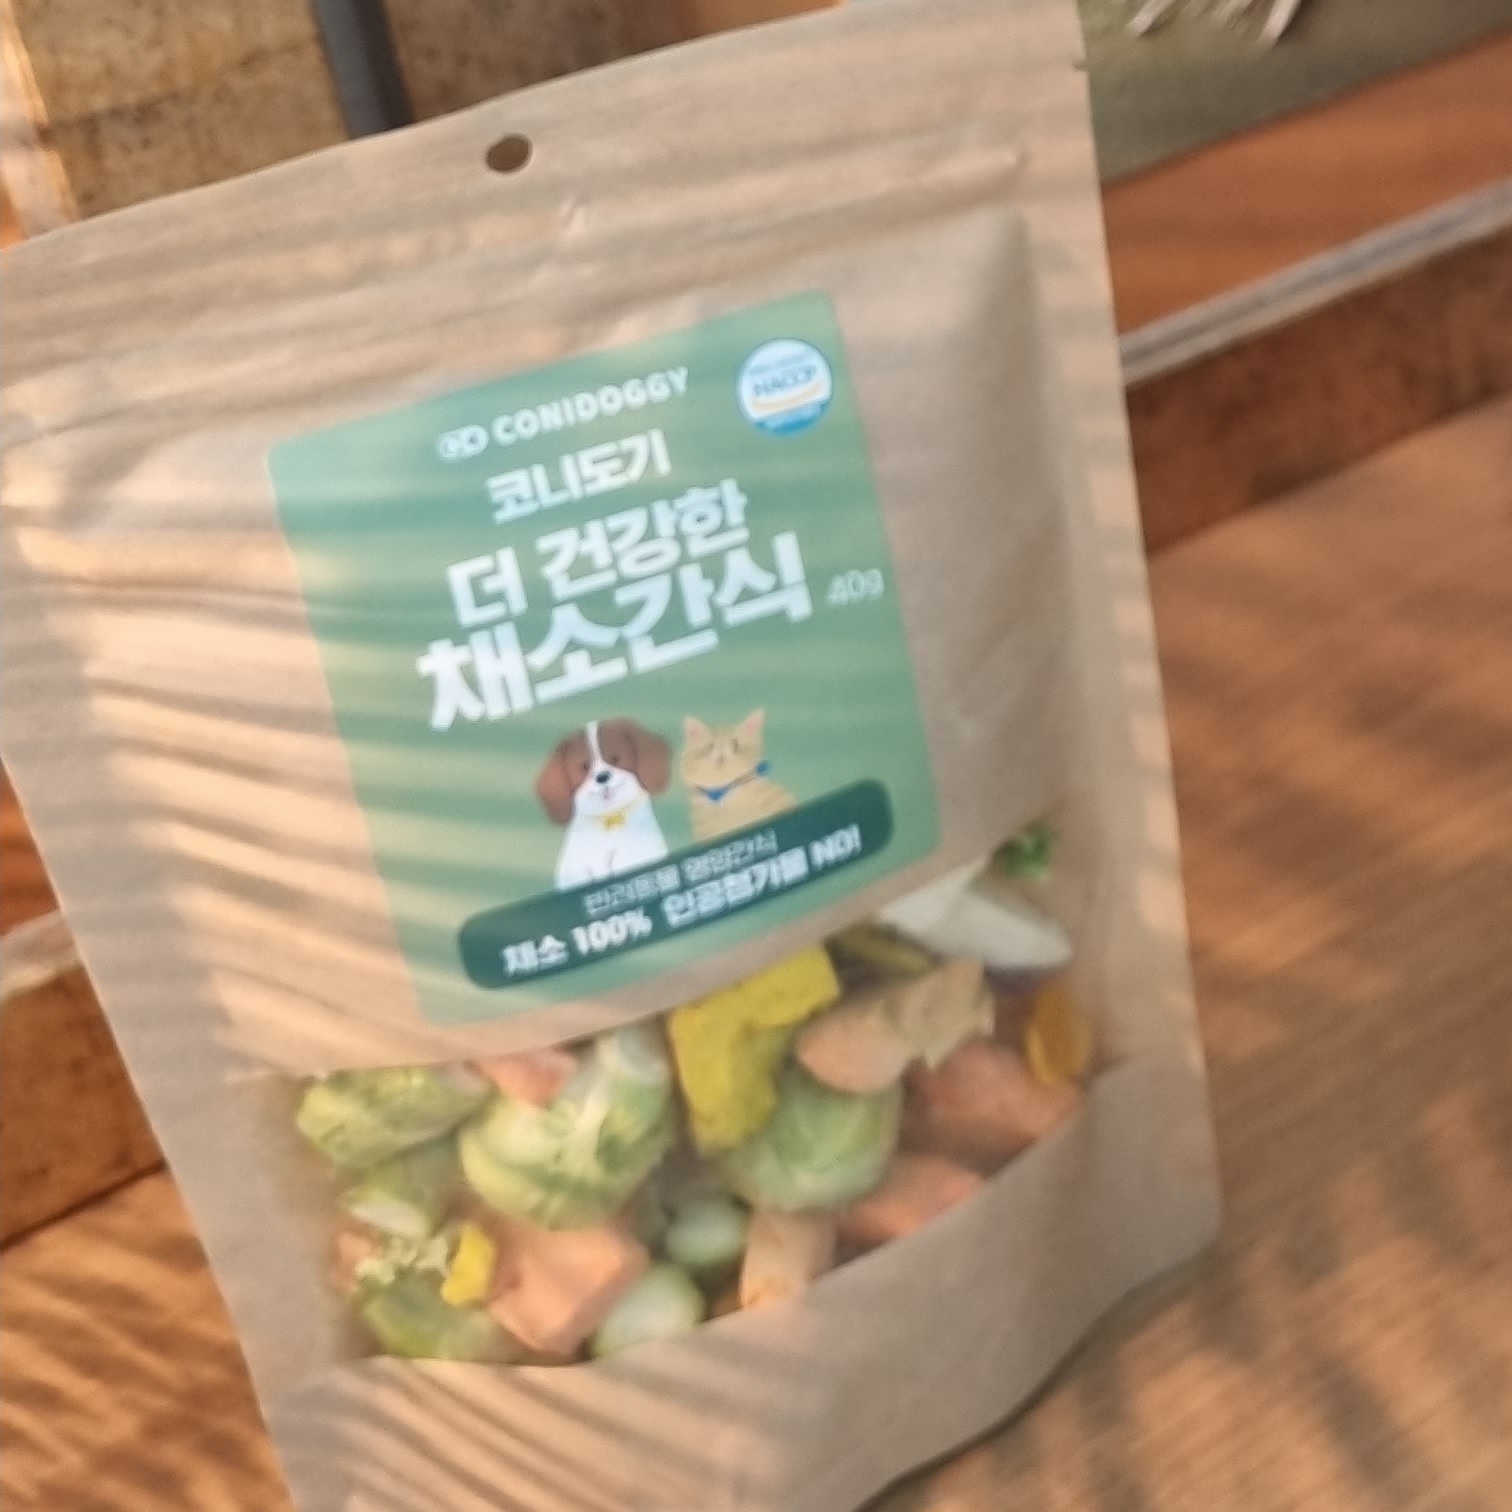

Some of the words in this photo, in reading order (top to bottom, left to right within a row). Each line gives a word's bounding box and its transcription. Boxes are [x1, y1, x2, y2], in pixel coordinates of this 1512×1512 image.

[490, 365, 689, 447] CONIDOGGY
[486, 427, 673, 524] 코니도기
[447, 546, 528, 628] 더
[535, 479, 749, 600] 건강한
[826, 567, 884, 606] 40g
[415, 531, 813, 730] 채소간식
[501, 937, 569, 977] 채소
[571, 908, 653, 956] 100%
[809, 823, 863, 871] NO!
